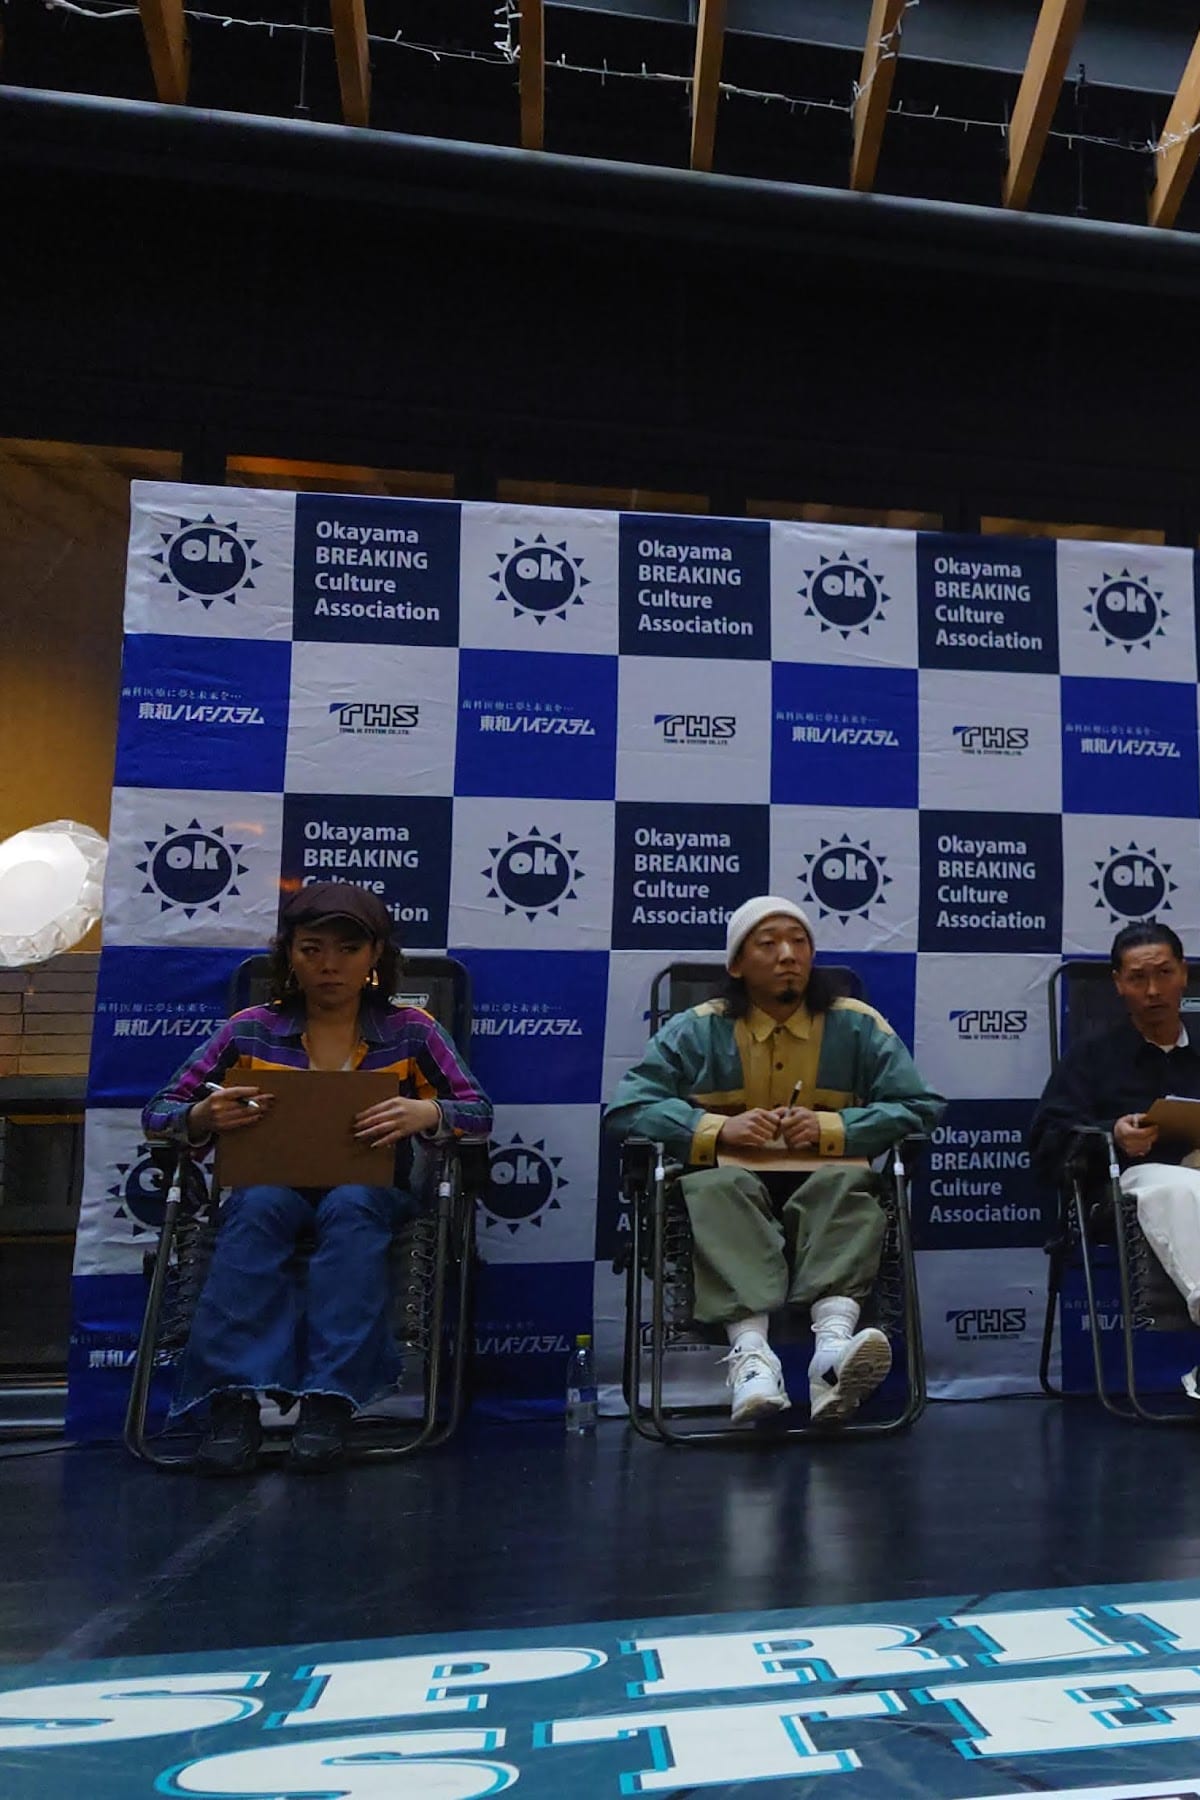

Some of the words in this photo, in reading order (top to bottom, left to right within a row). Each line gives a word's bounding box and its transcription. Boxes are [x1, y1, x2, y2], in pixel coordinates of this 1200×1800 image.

[316, 521, 419, 545] Okayama
[316, 546, 428, 569] BREAKING
[638, 540, 732, 562] Okayama
[639, 564, 741, 585] BREAKING
[934, 557, 1022, 579] Okayama
[315, 572, 396, 593] Culture
[935, 581, 1031, 602] BREAKING
[314, 598, 440, 621] Association
[638, 589, 713, 609] Culture
[638, 614, 753, 635] Association
[935, 604, 1004, 624] Culture
[936, 629, 1042, 650] Association
[138, 702, 264, 725] 東和ハイシステム
[329, 703, 419, 727] THS
[480, 715, 596, 735] 東和ハイシステム
[654, 714, 736, 738] THS
[953, 726, 1028, 749] THS
[304, 821, 409, 845] Okayama
[634, 828, 731, 851] Okayama
[938, 835, 1027, 858] Okayama
[304, 848, 419, 868] BREAKING
[634, 854, 740, 873] BREAKING
[938, 860, 1036, 879] BREAKING
[633, 880, 710, 898] Culture
[938, 885, 1008, 903] Culture
[632, 906, 735, 924] Associati
[936, 910, 1046, 929] Association
[949, 1010, 1027, 1032] THS
[931, 1126, 1022, 1148] Okayama
[931, 1152, 1030, 1170] BREAKING
[930, 1178, 1002, 1197] Culture
[929, 1204, 1041, 1223] Association
[946, 1308, 1026, 1333] THS
